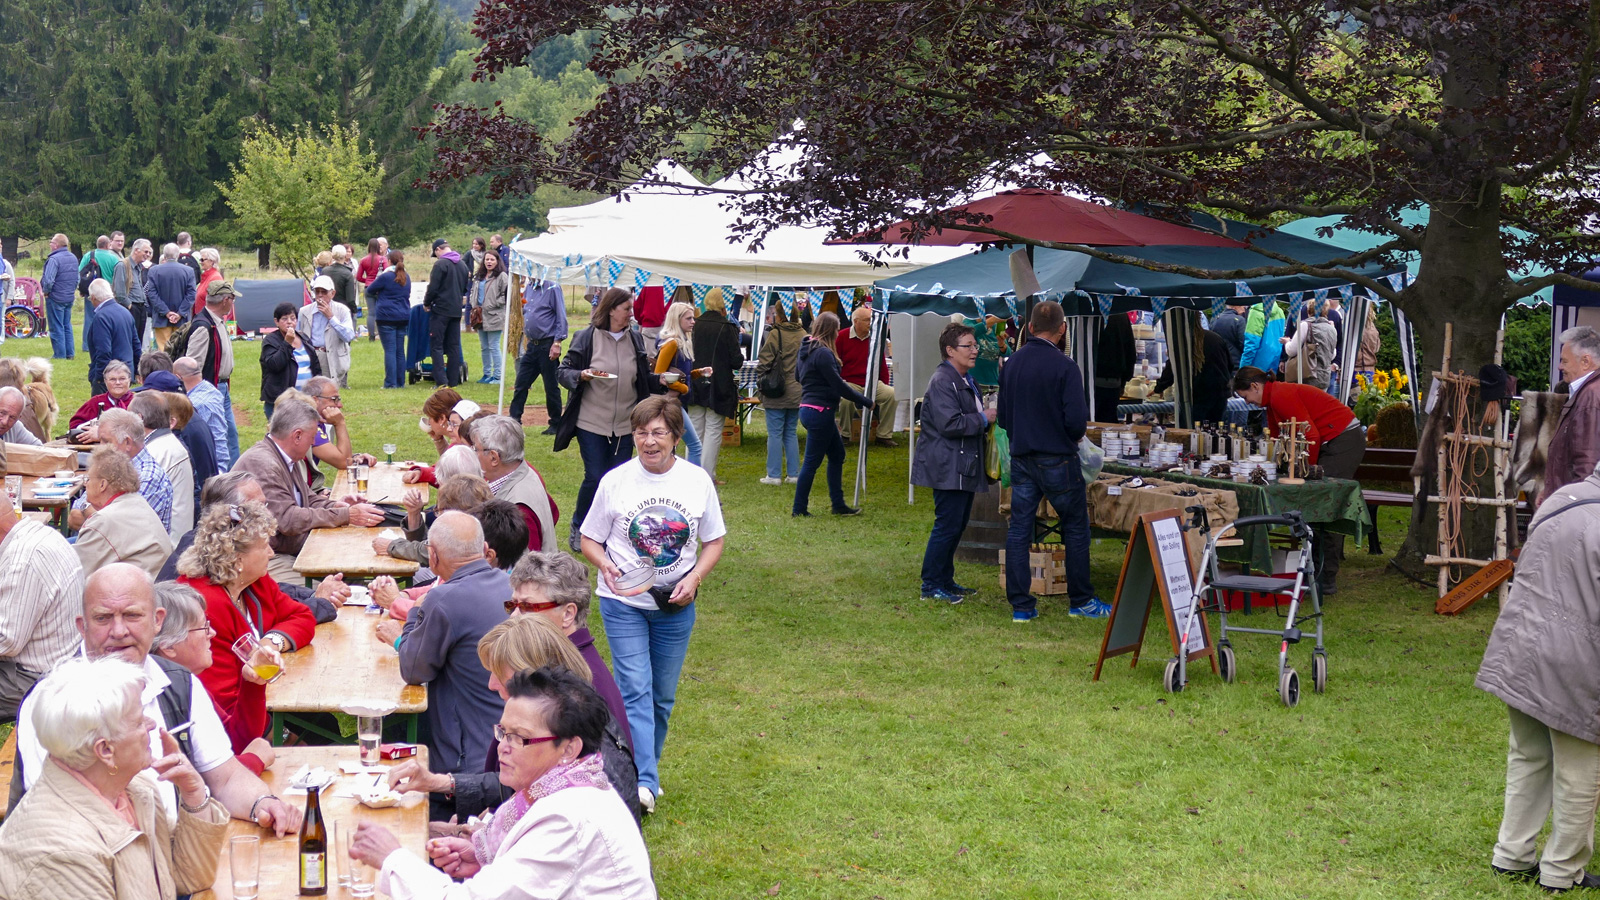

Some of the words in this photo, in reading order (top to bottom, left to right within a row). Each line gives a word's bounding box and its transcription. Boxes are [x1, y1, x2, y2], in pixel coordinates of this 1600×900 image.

[637, 497, 657, 510] UND
[1444, 590, 1466, 607] LASS
[1466, 579, 1482, 592] DIR
